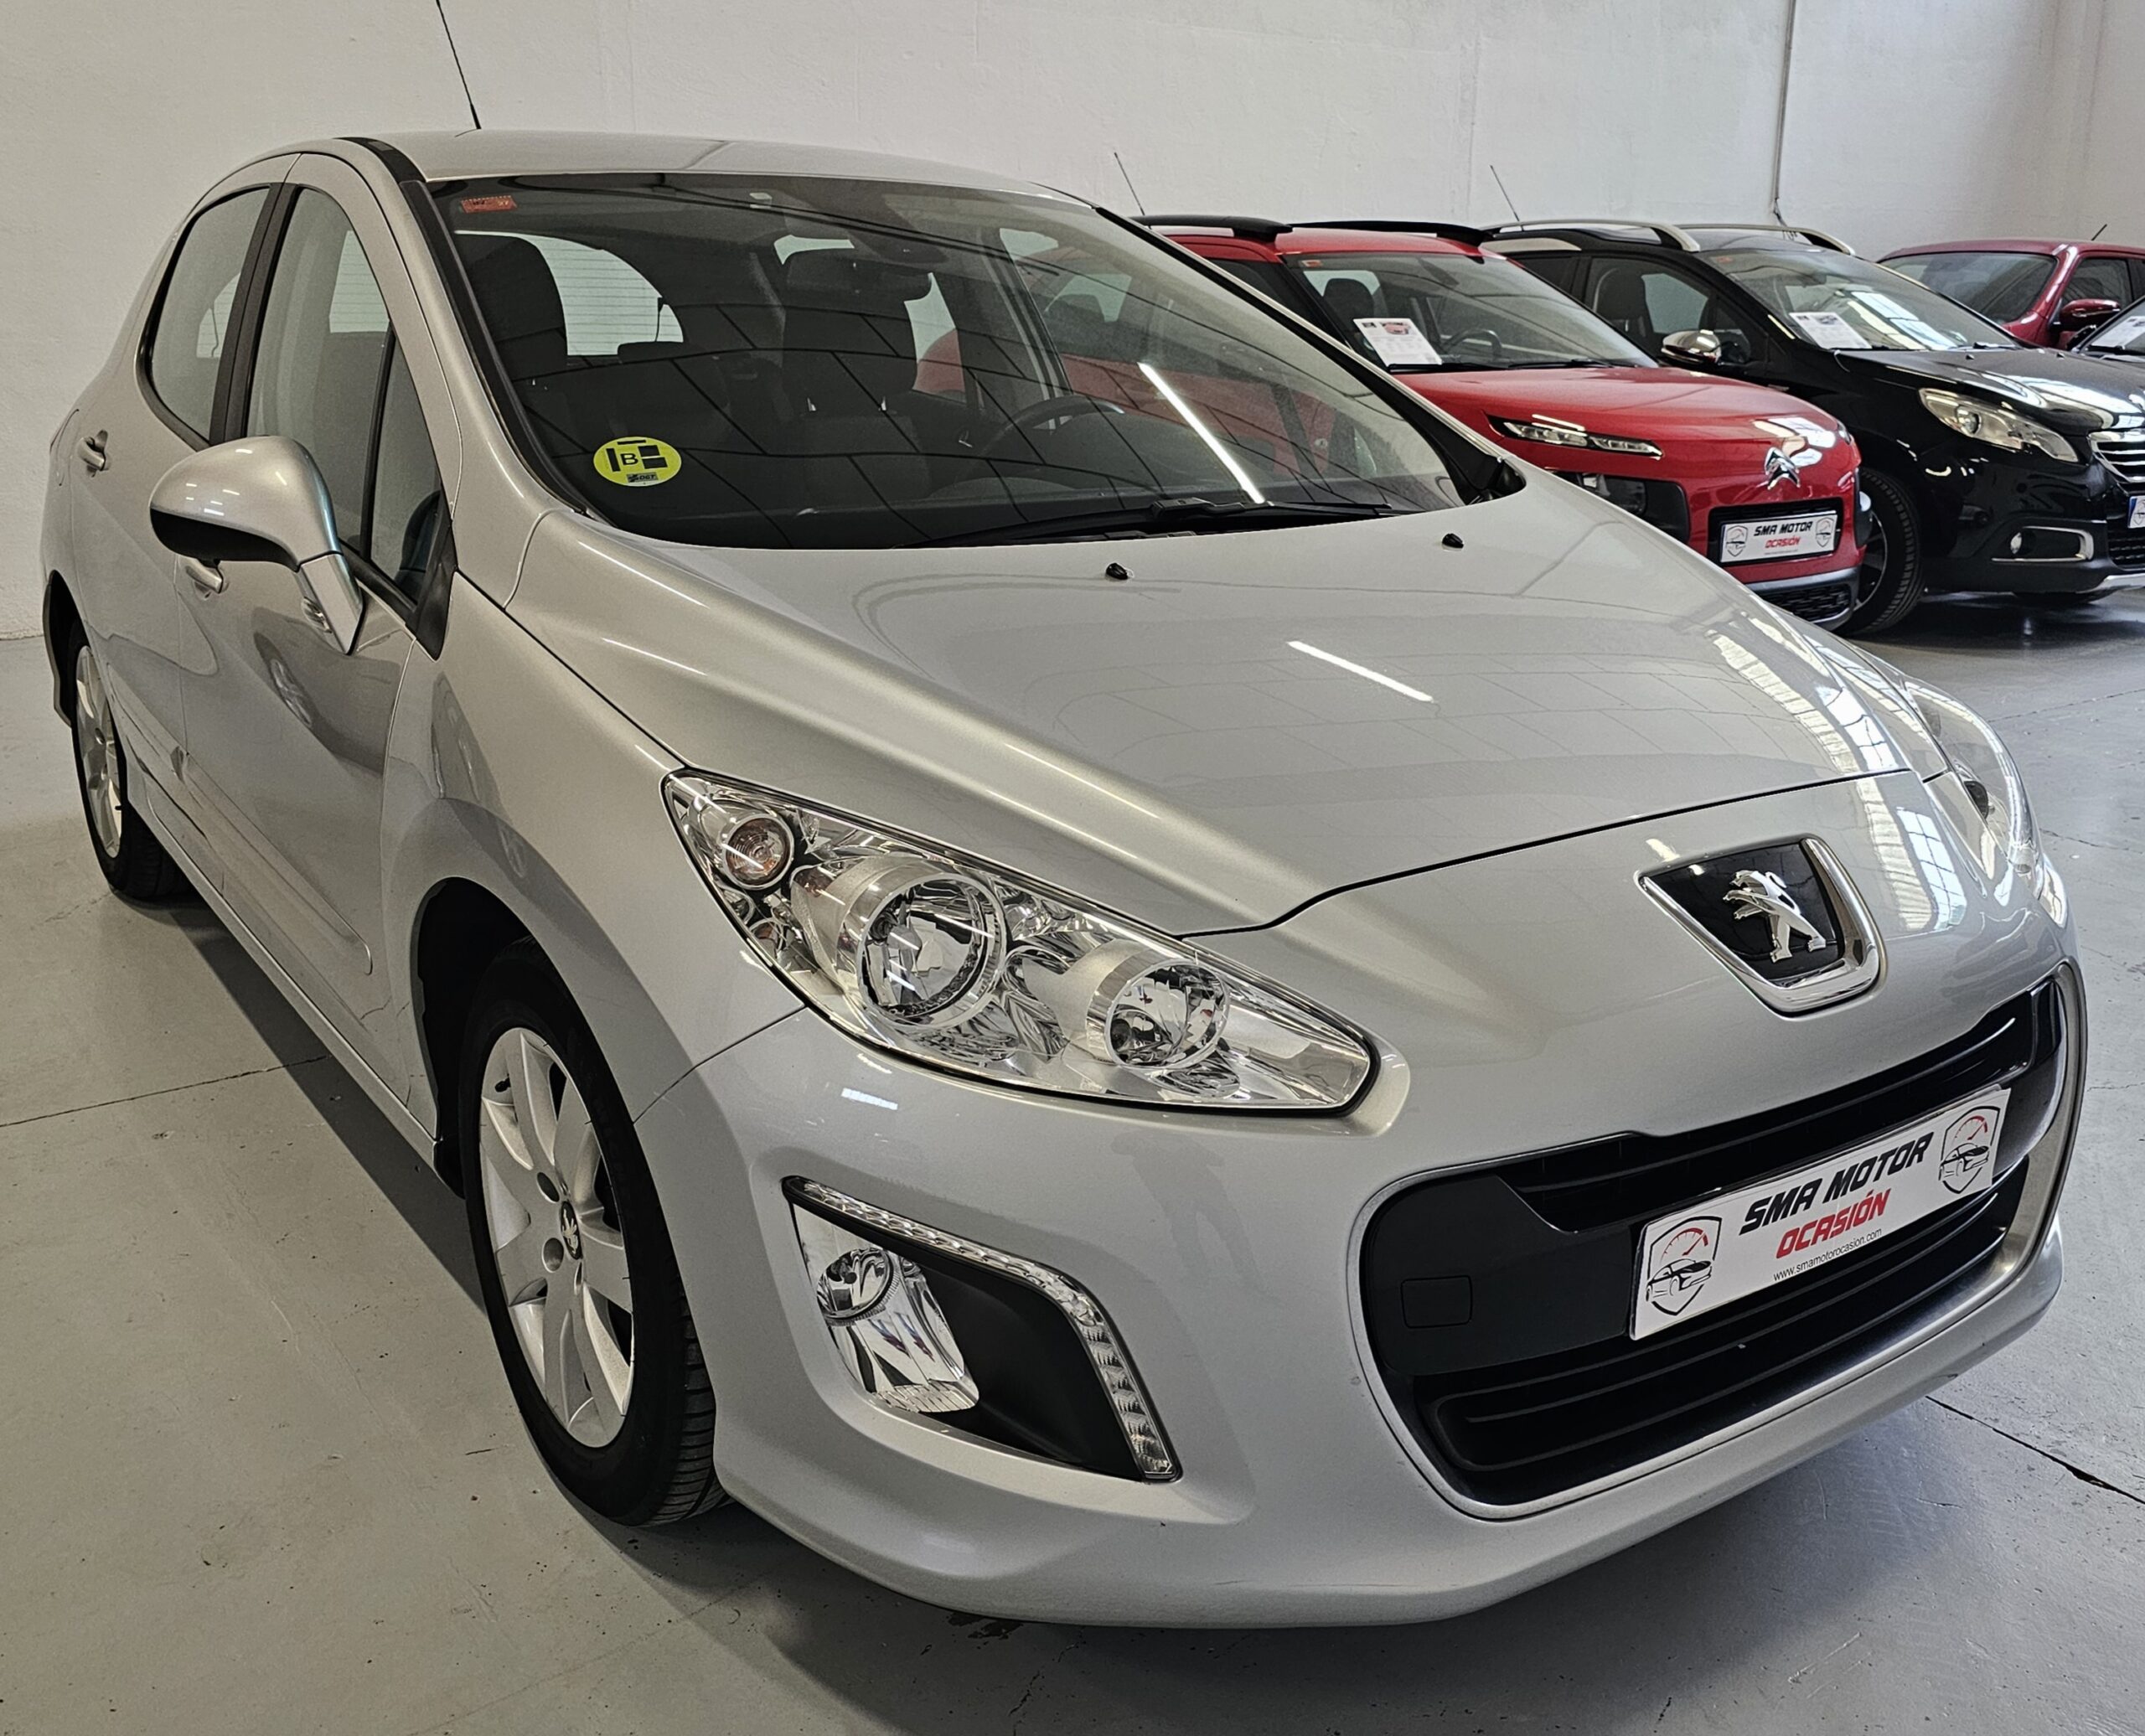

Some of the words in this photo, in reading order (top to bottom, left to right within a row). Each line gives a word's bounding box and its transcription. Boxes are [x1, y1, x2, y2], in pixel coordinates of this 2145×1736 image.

[620, 453, 638, 465] B
[1754, 524, 1777, 536] SMA
[1780, 521, 1813, 534] MOTOR
[1739, 1178, 1822, 1236] SMA
[1822, 1132, 1934, 1203] MOTOR
[1775, 1188, 1891, 1258] OCASIÓN
[1773, 1228, 1882, 1281] www.smamotorocasion.com
